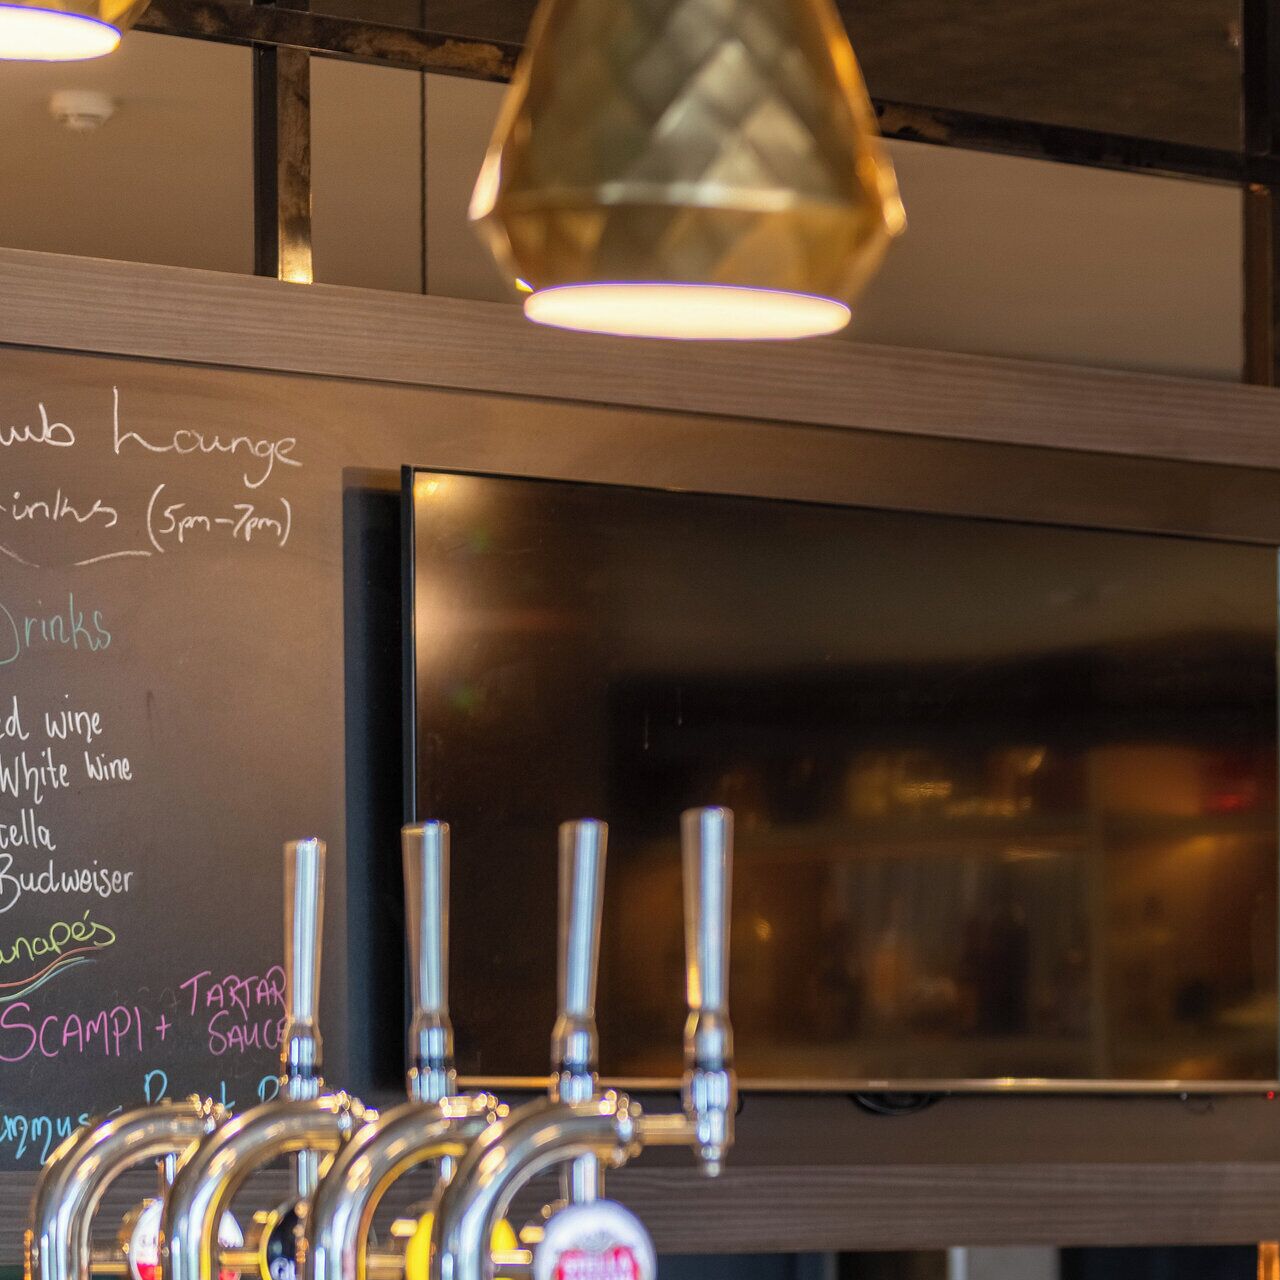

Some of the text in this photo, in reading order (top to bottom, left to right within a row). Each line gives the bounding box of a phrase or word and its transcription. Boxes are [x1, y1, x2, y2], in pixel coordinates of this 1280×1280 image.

[0, 487, 118, 528] inks
[45, 693, 102, 744] wine
[0, 851, 134, 914] Budweiser
[0, 1002, 143, 1063] SCAMPI
